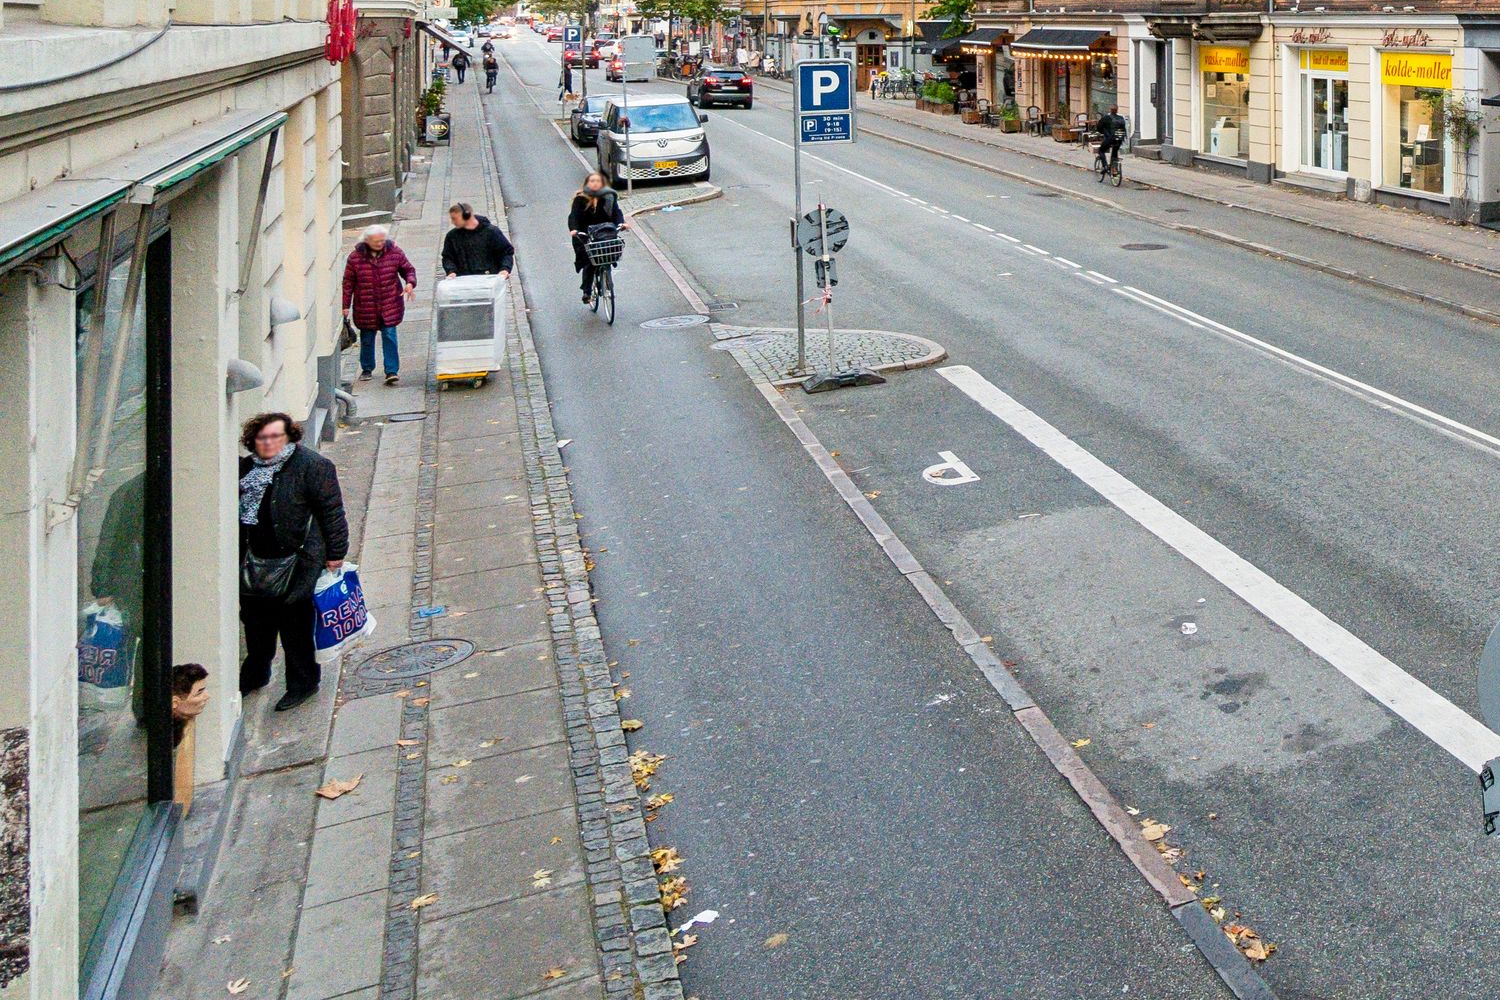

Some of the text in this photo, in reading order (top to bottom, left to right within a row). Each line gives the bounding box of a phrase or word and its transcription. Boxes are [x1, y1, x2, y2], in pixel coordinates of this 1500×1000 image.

[568, 29, 578, 41] P
[813, 70, 840, 106] P
[807, 121, 814, 130] P
